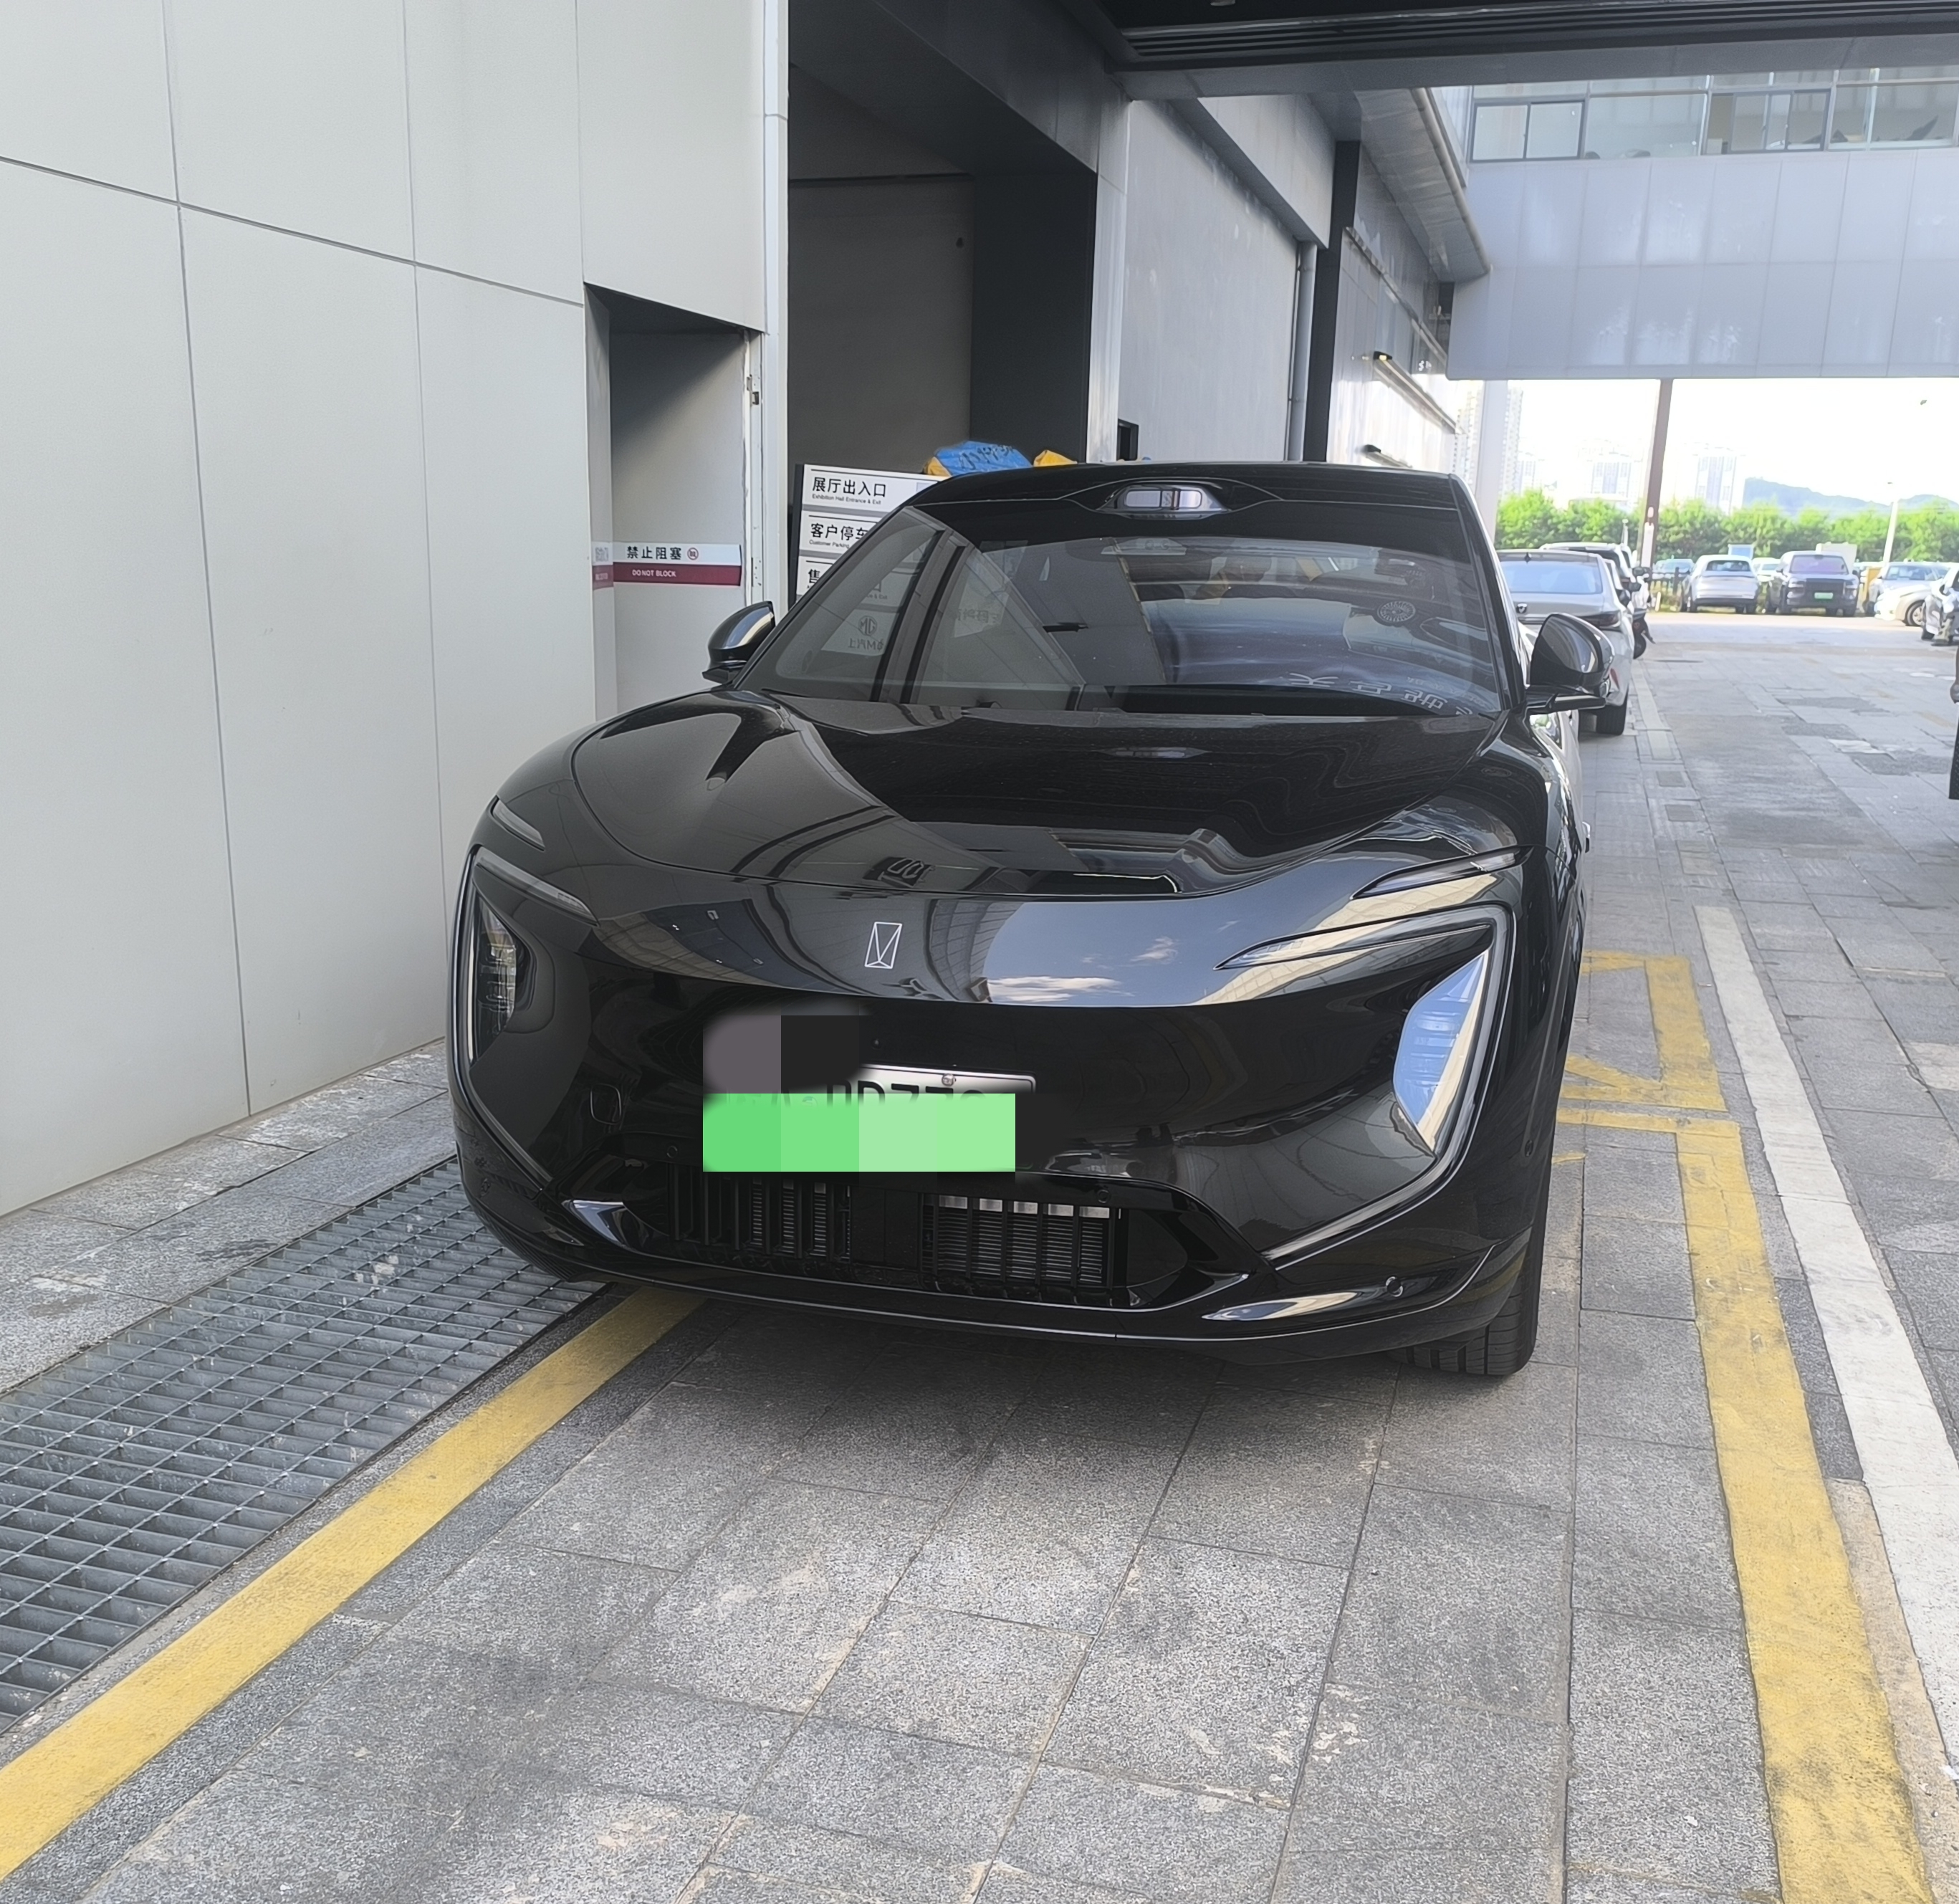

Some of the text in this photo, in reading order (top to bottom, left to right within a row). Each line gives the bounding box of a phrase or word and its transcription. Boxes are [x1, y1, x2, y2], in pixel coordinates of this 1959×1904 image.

[812, 477, 886, 497] 展厅出入口
[626, 545, 681, 560] 禁止阻塞
[859, 616, 877, 636] MG
